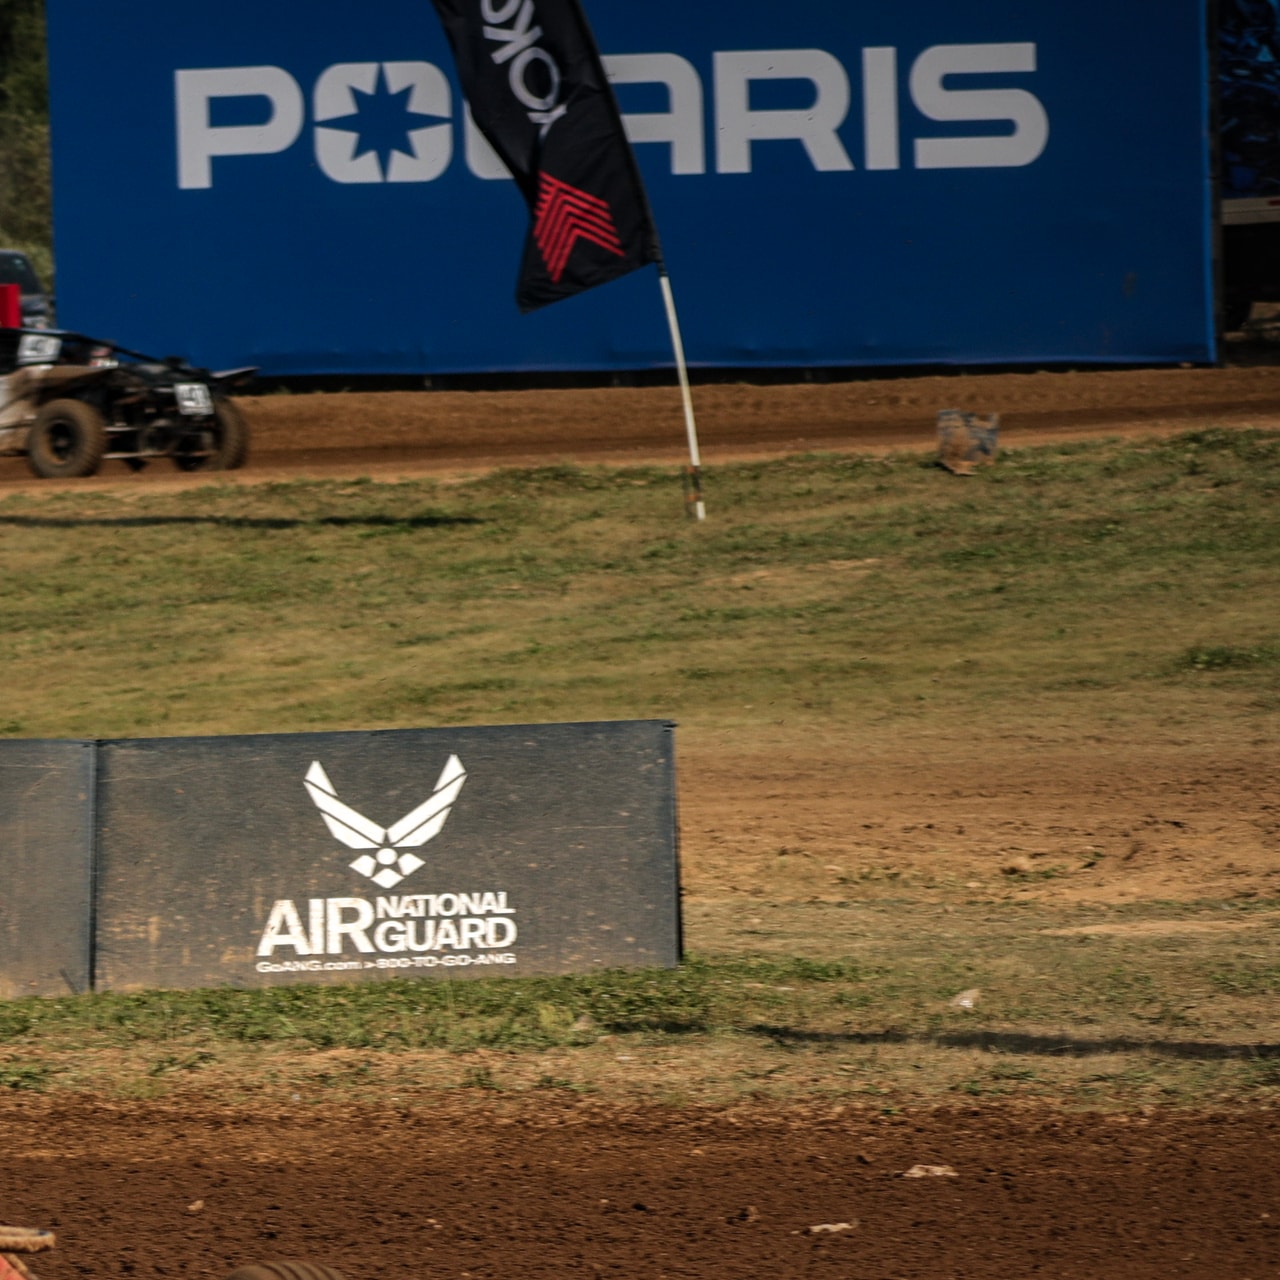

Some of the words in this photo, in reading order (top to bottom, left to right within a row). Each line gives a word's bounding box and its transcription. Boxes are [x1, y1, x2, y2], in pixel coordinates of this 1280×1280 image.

[376, 891, 517, 919] NATIONAL
[256, 896, 377, 957] AIR
[373, 916, 518, 952] GUARD
